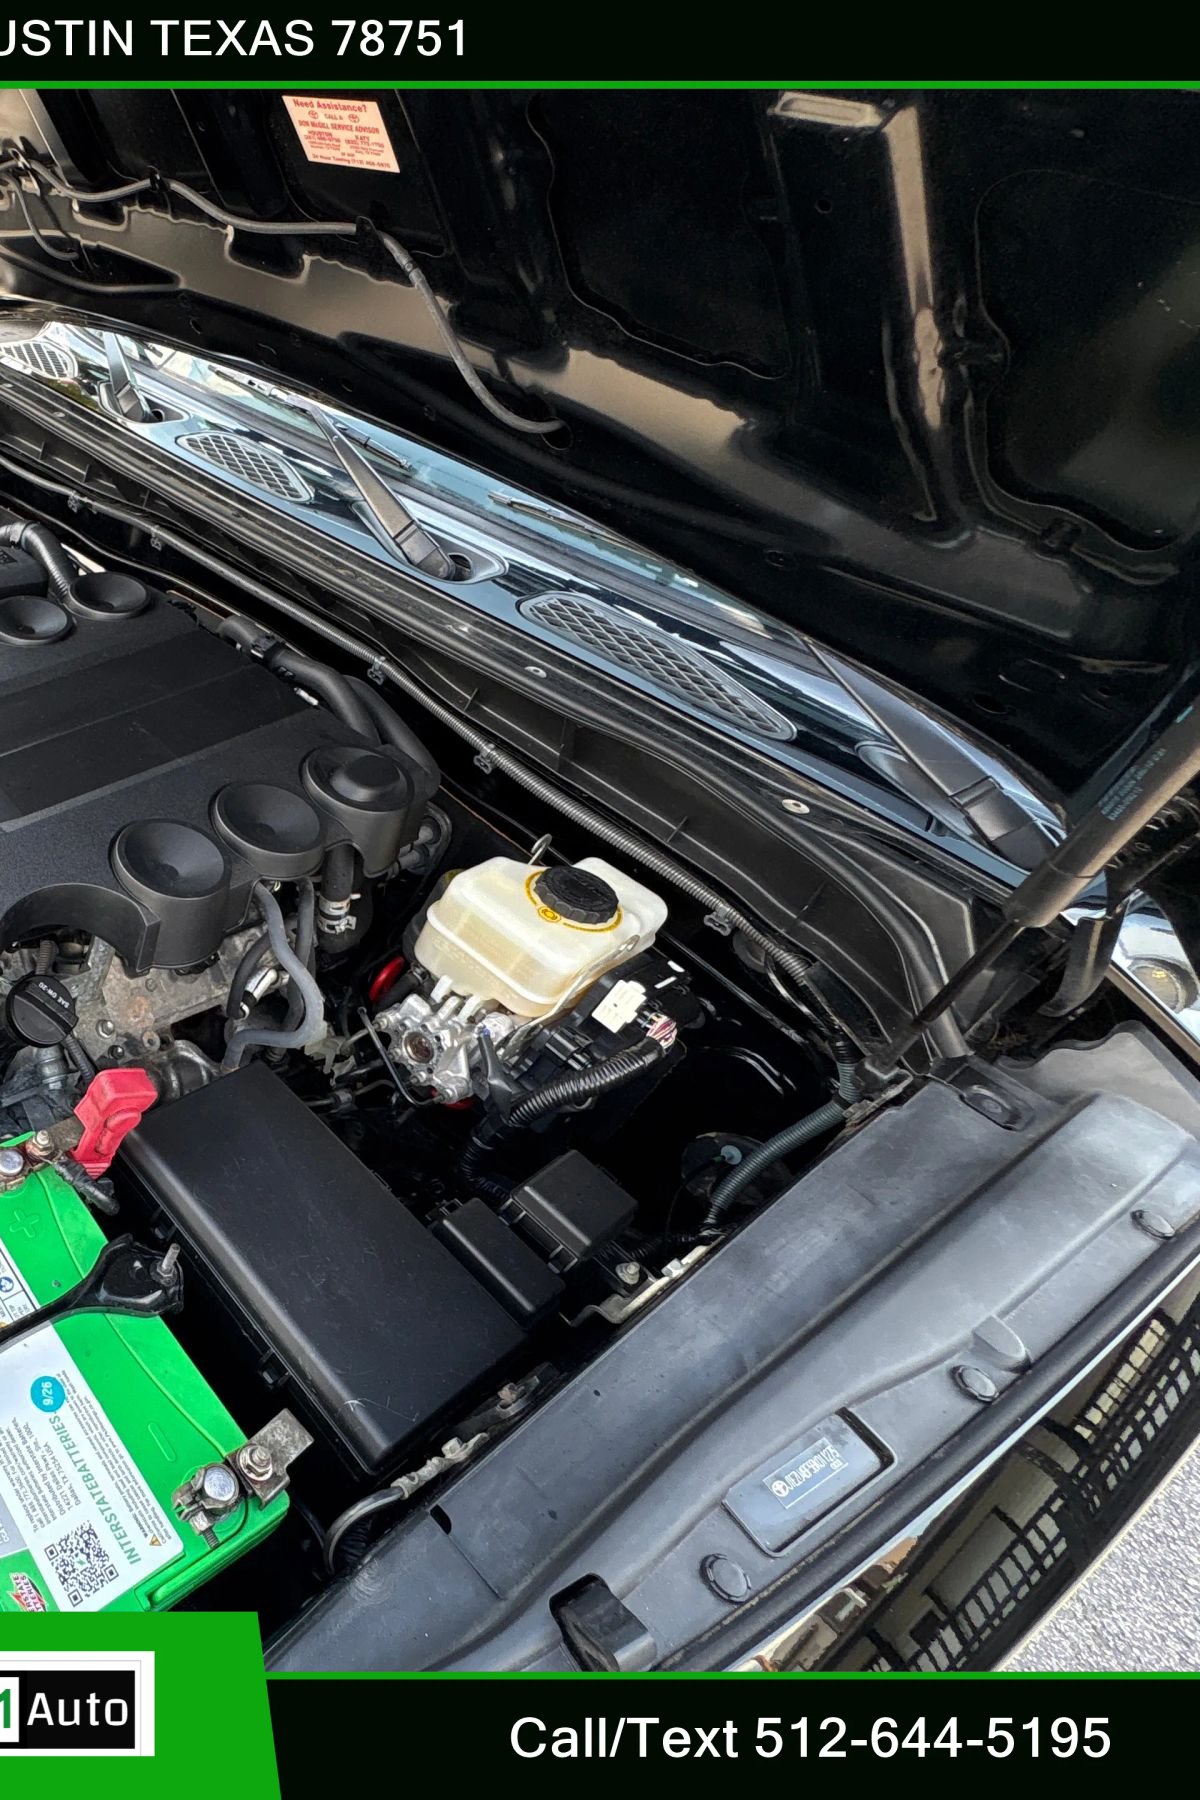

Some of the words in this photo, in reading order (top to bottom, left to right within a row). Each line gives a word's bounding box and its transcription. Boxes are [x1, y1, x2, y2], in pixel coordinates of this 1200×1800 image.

[292, 99, 314, 108] Need
[317, 100, 367, 112] Assistance?
[331, 123, 354, 132] SERVICE
[355, 125, 379, 134] ADVISOR
[57, 995, 70, 1009] SAE
[41, 1381, 54, 1407] 9/26
[43, 1480, 67, 1516] Distributed
[45, 1409, 142, 1566] INTERSTATEBATTERIES.
[12, 1574, 35, 1613] ERSTATE
[19, 1573, 42, 1611] TTERIES
